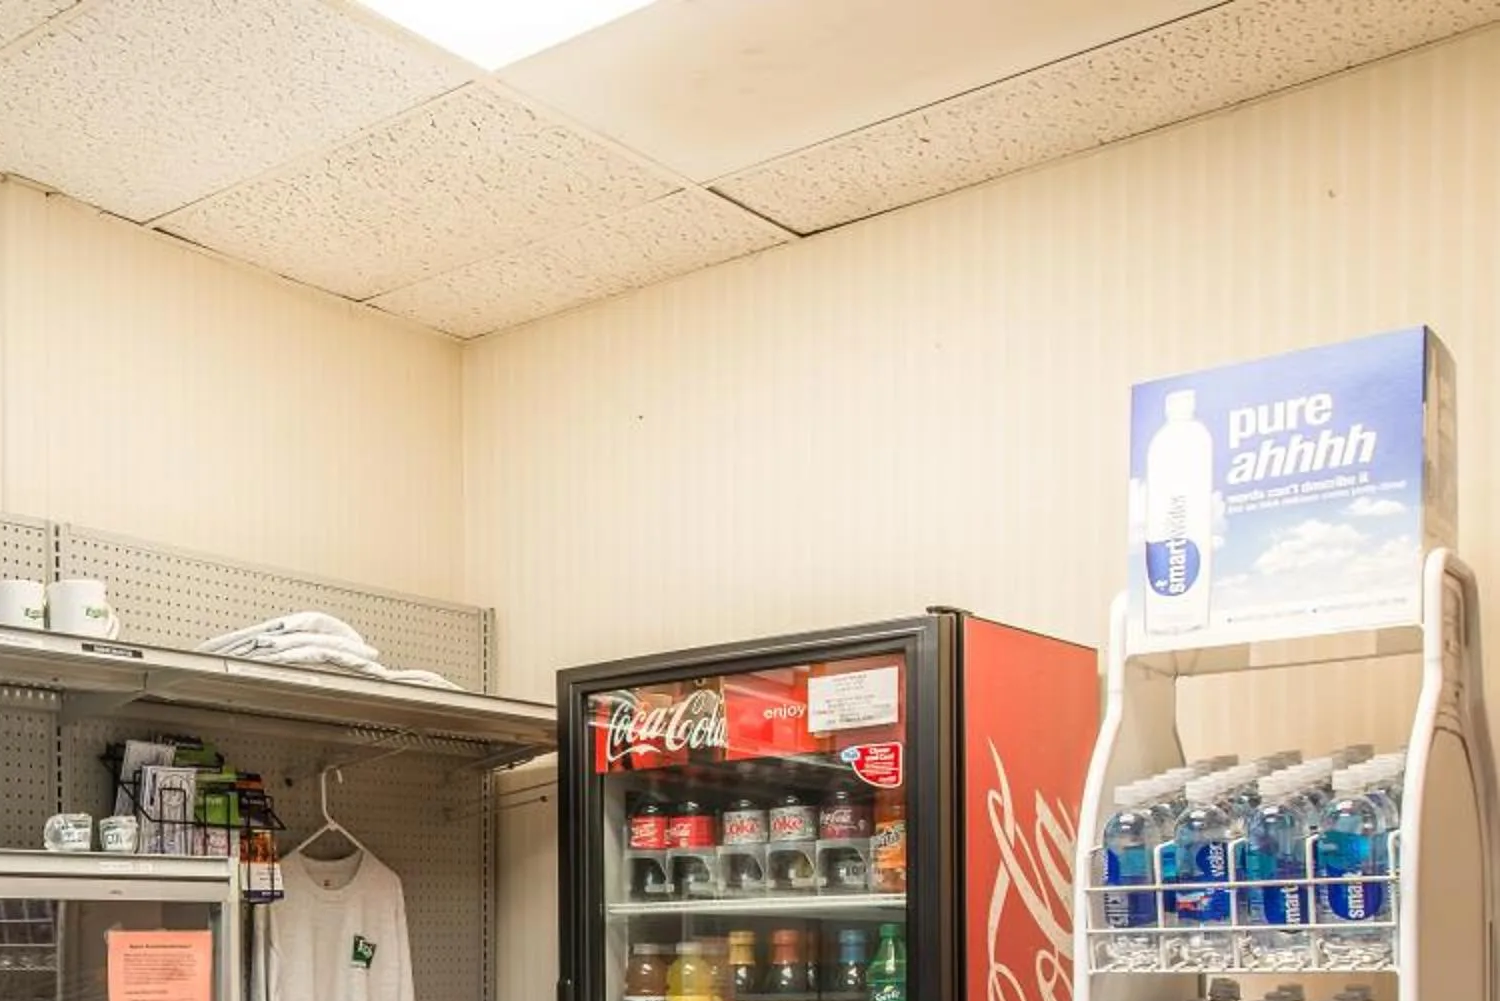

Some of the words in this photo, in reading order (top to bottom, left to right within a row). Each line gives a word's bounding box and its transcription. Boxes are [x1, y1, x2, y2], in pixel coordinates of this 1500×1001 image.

[1228, 391, 1333, 450] pure
[1227, 423, 1378, 486] ahhhh
[763, 703, 806, 721] enjoy
[1280, 885, 1300, 925] mart
